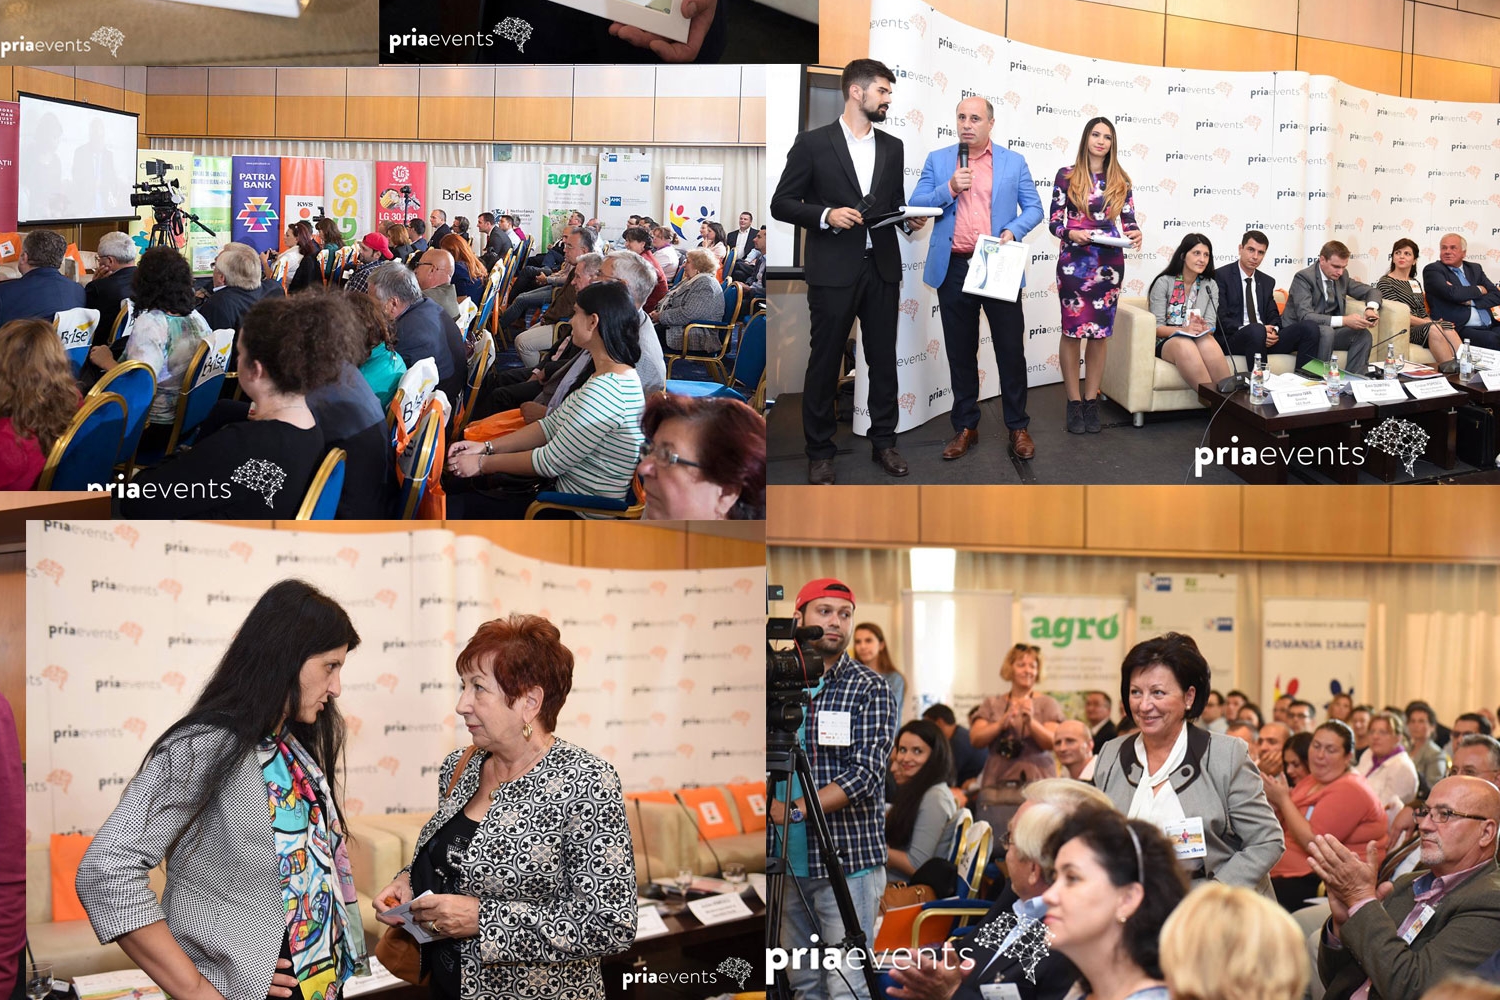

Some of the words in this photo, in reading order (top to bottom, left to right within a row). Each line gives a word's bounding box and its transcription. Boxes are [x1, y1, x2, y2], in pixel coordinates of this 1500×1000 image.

[938, 36, 978, 58] priaevents
[1010, 60, 1054, 77] priaevents
[1087, 75, 1134, 89] priaevents
[1168, 84, 1215, 95] priaevents
[1251, 87, 1300, 98] priaevents
[1037, 103, 1081, 118] priaevents
[1196, 119, 1243, 130] priaevents
[1431, 113, 1467, 123] priaevents
[1008, 137, 1052, 151] priaevents
[239, 173, 276, 181] PATRIA
[398, 170, 404, 178] LG
[442, 189, 472, 200] Brise
[379, 212, 390, 220] LG
[61, 329, 88, 344] Brise
[202, 354, 226, 377] Brise
[165, 541, 229, 559] priaevents
[92, 578, 158, 597] priaevents
[49, 623, 120, 641] priaevents
[1266, 639, 1322, 650] ROMANIA
[1326, 639, 1364, 650] ISRAEL
[96, 677, 161, 692] priaevents
[54, 726, 124, 743] priaevents
